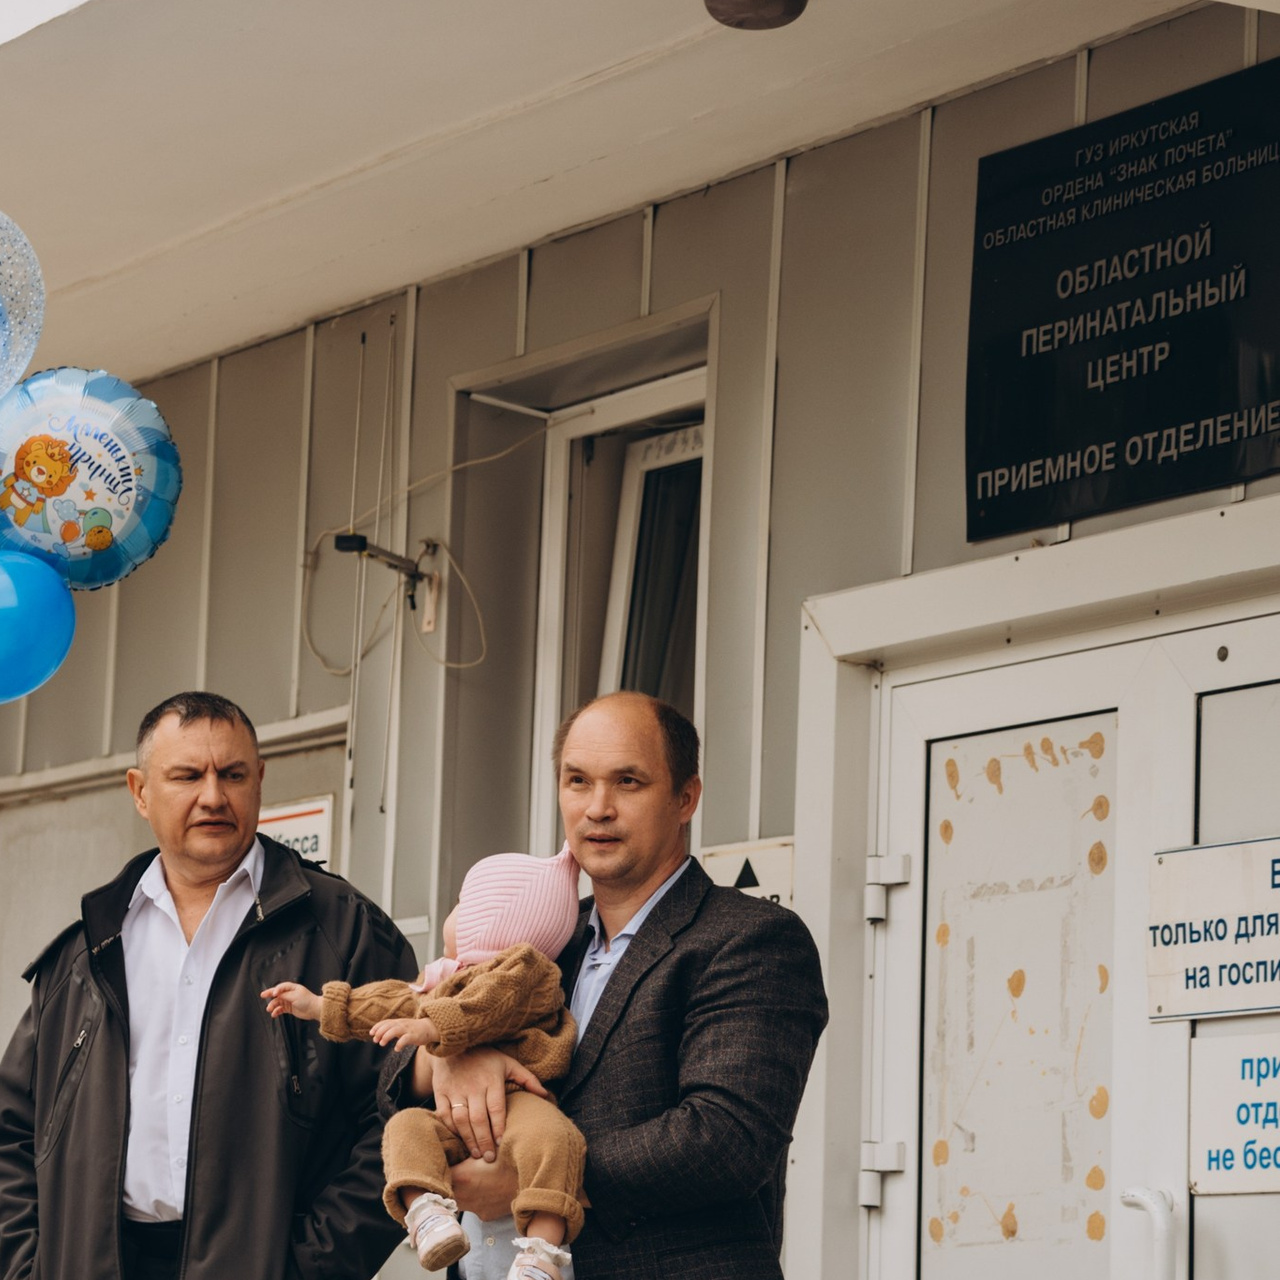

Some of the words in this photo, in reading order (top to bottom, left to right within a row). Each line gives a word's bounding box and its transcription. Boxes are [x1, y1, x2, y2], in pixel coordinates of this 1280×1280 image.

[1075, 143, 1104, 168] ГУЗ
[1109, 111, 1200, 156] ИРКУТСКАЯ
[982, 207, 1077, 251] ОБЛАСТНАЯ
[1081, 170, 1197, 225] КЛИНИЧЕСКАЯ
[1041, 171, 1105, 207] ОРДЕНА
[1056, 222, 1213, 300] ОБЛАСТНОЙ
[1021, 263, 1247, 358] ПЕРИНАТАЛЬНЫЙ
[1087, 341, 1171, 391] ЦЕНТР
[1124, 399, 1280, 467] ОТДЕЛЕНИЕ
[976, 442, 1117, 500] ПРИЕМНОЕ
[1148, 918, 1228, 948] только
[1235, 912, 1280, 945] для
[1185, 964, 1210, 990] на
[1236, 1102, 1280, 1130] отд
[1207, 1147, 1236, 1172] не
